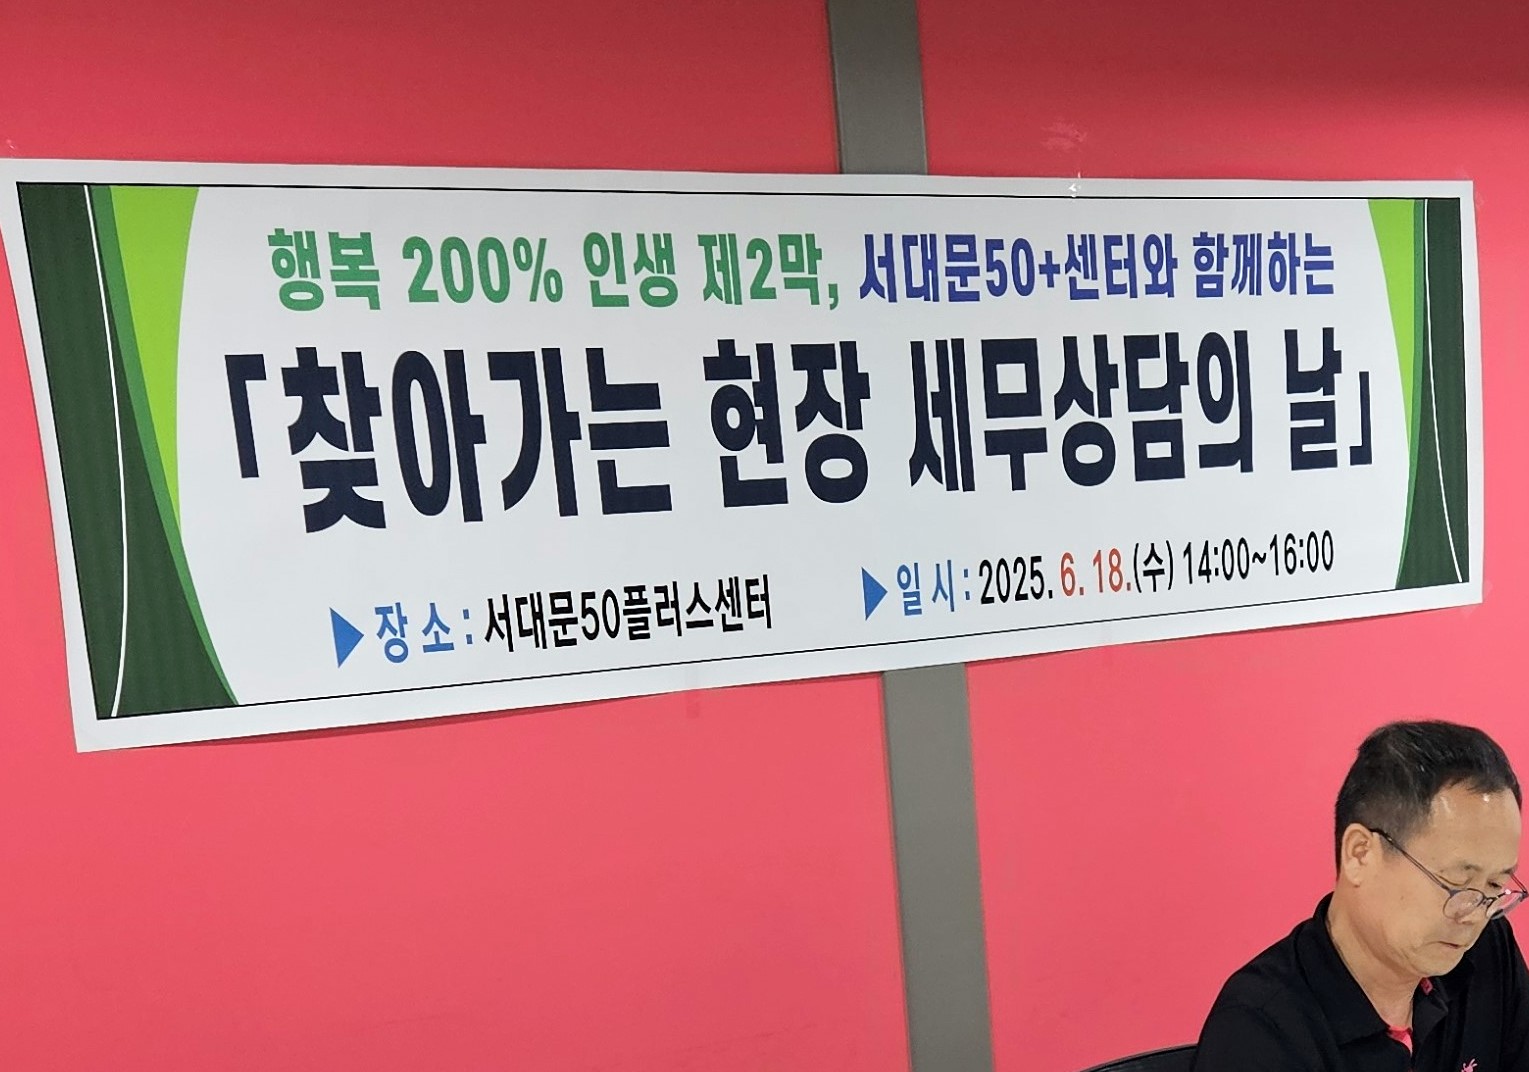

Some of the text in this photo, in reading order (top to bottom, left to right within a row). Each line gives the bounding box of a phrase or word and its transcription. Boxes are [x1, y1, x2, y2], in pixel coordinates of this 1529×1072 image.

[268, 228, 1336, 312] 행복 200% 인생 제2막, 서대문50+센터와 함께하는
[225, 327, 1374, 534] 「찾아가는 현장 세무상담의 날」
[979, 556, 1054, 606] 2025.
[1183, 530, 1335, 586] 14:00~16:00
[485, 574, 774, 653] 서대문50플러스센터
